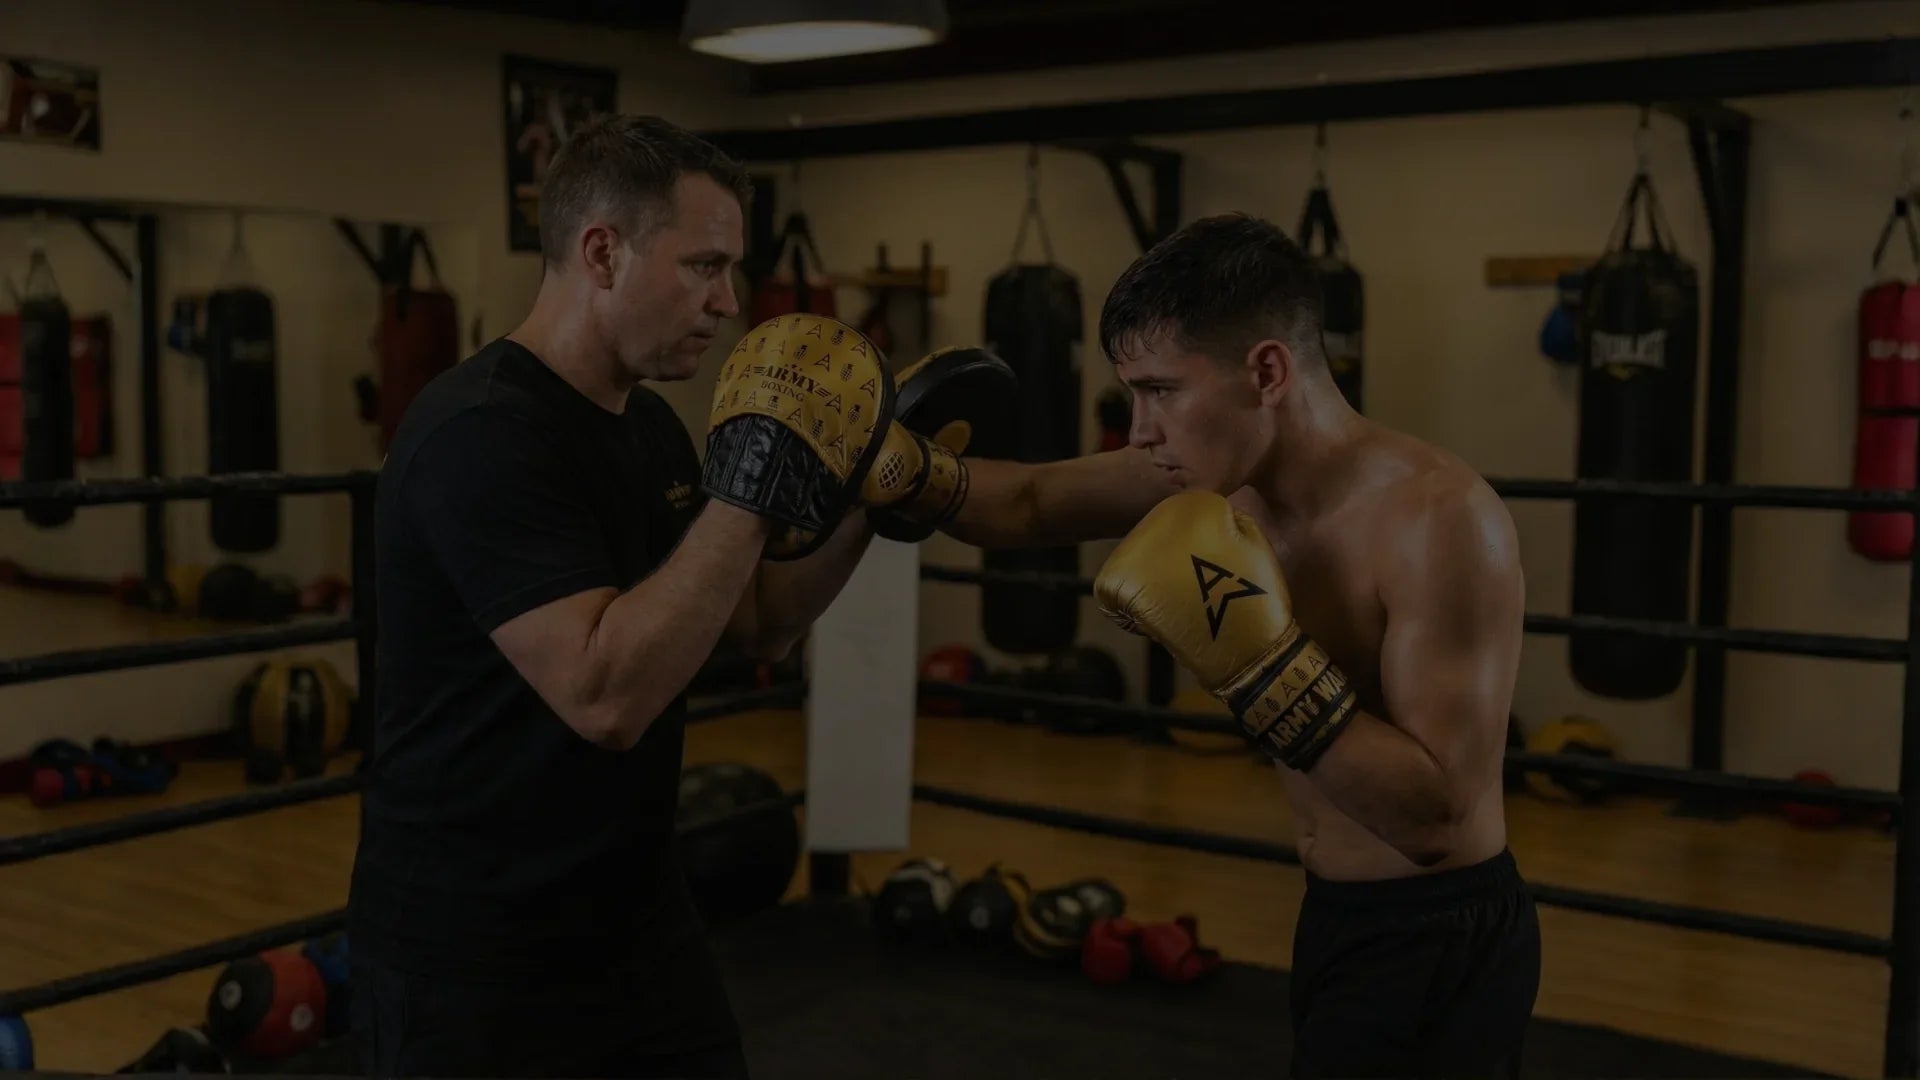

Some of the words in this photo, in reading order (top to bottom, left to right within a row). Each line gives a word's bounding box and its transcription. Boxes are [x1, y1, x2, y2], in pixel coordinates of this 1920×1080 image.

[761, 365, 820, 393] ARMY
[761, 380, 804, 402] BOXING
[1267, 693, 1320, 750] ARMY
